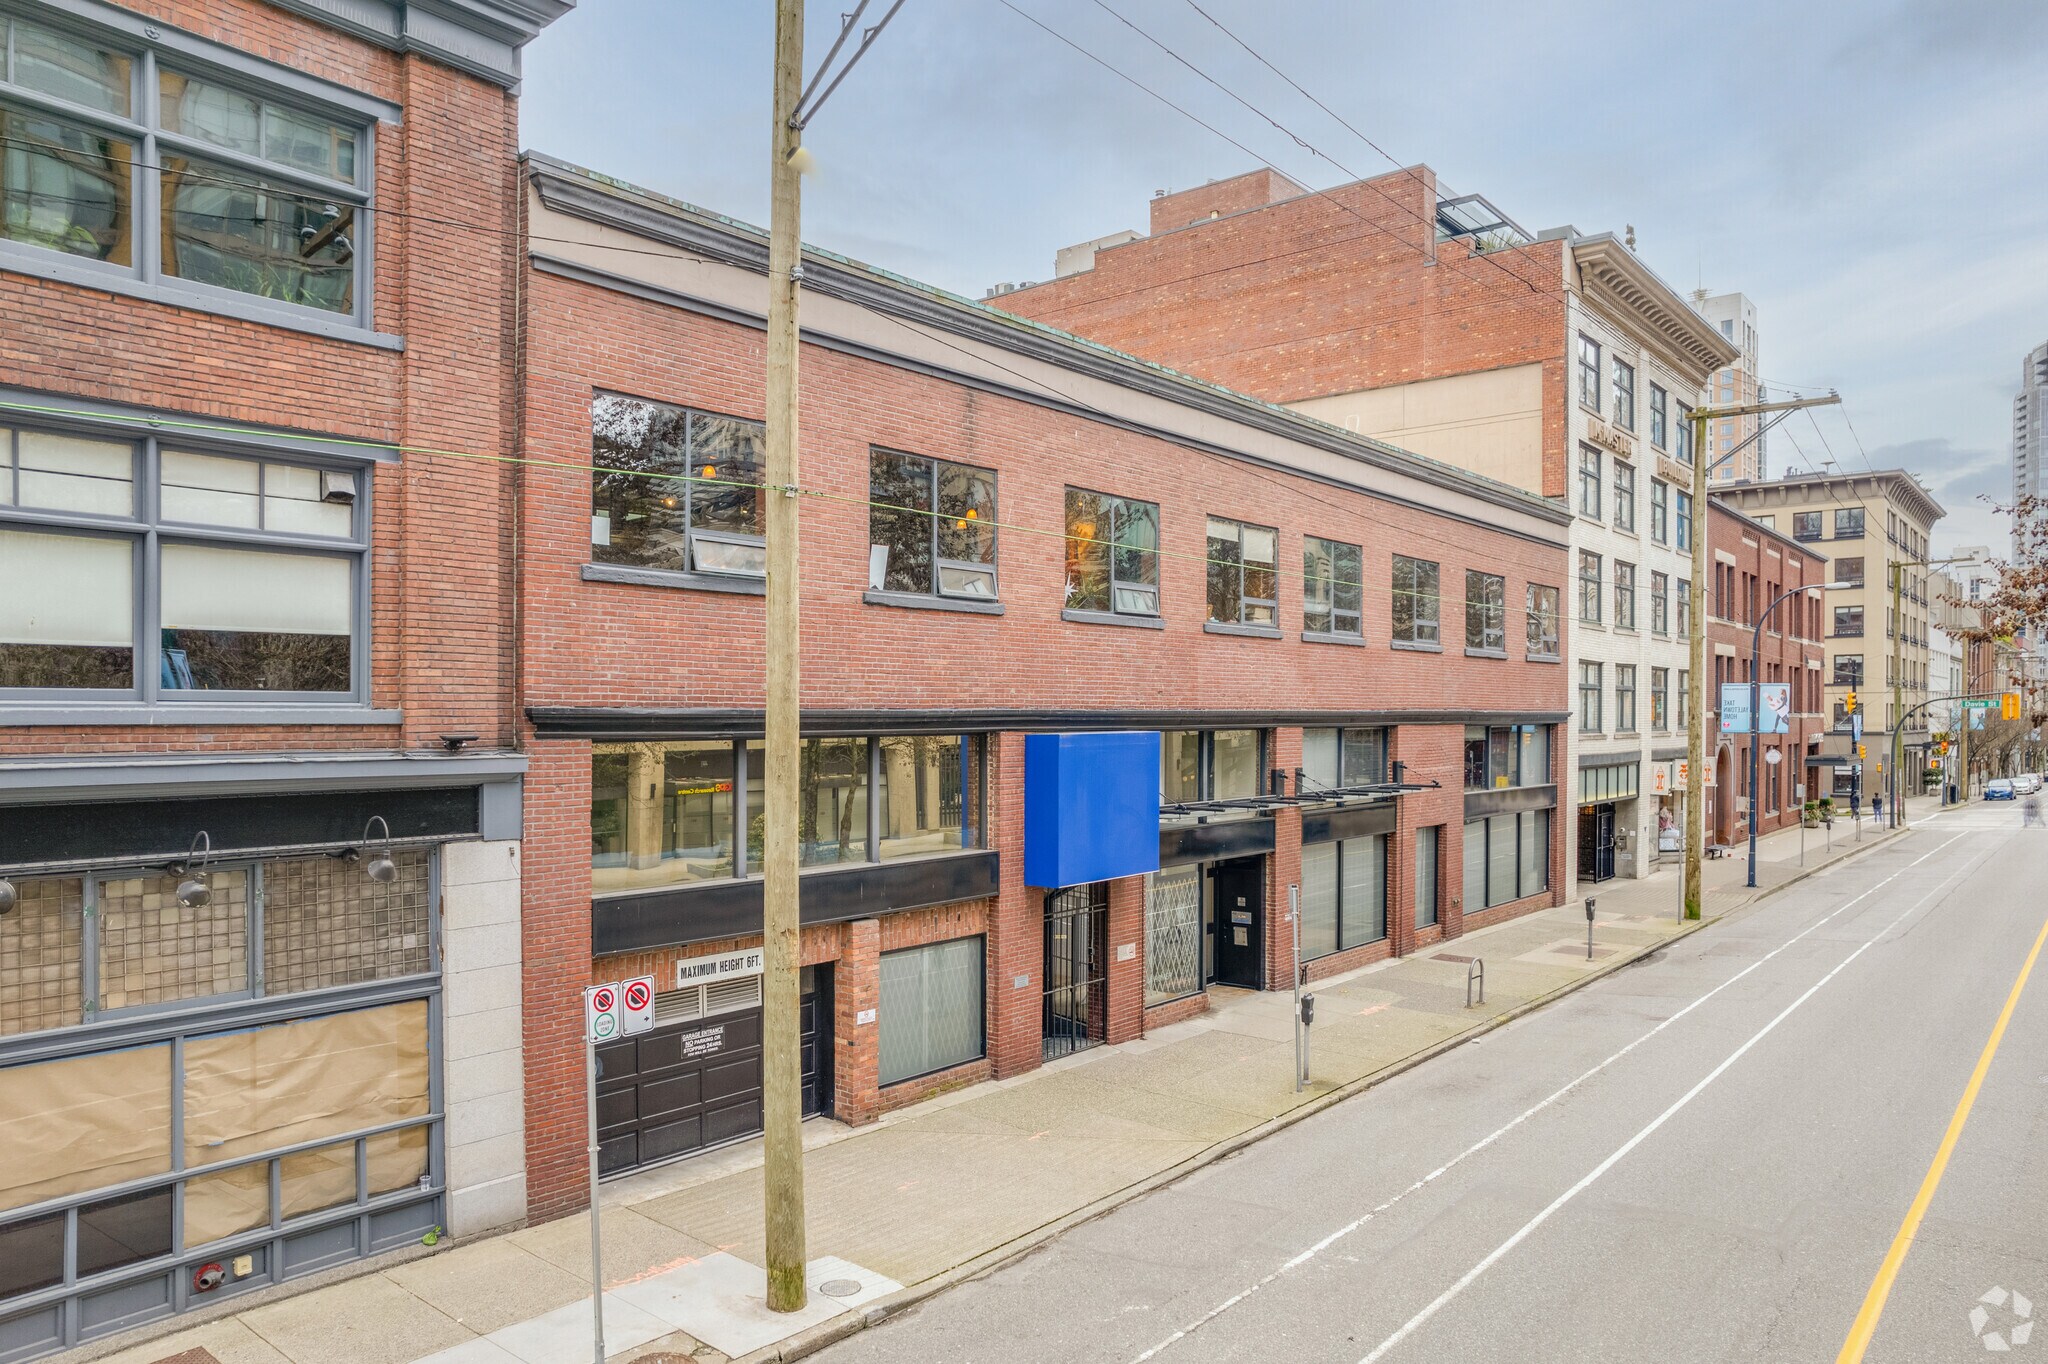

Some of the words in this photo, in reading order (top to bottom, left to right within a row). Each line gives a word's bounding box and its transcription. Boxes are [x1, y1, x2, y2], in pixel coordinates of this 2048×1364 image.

[681, 962, 717, 979] MAXIMUM
[719, 957, 744, 973] HEIGHT
[747, 955, 761, 968] 6FT.
[682, 1031, 701, 1041] GARAGE
[701, 1027, 723, 1037] ENTRANCE
[683, 1044, 706, 1053] STOPPING
[685, 1040, 694, 1048] NO
[694, 1036, 713, 1045] PARKING
